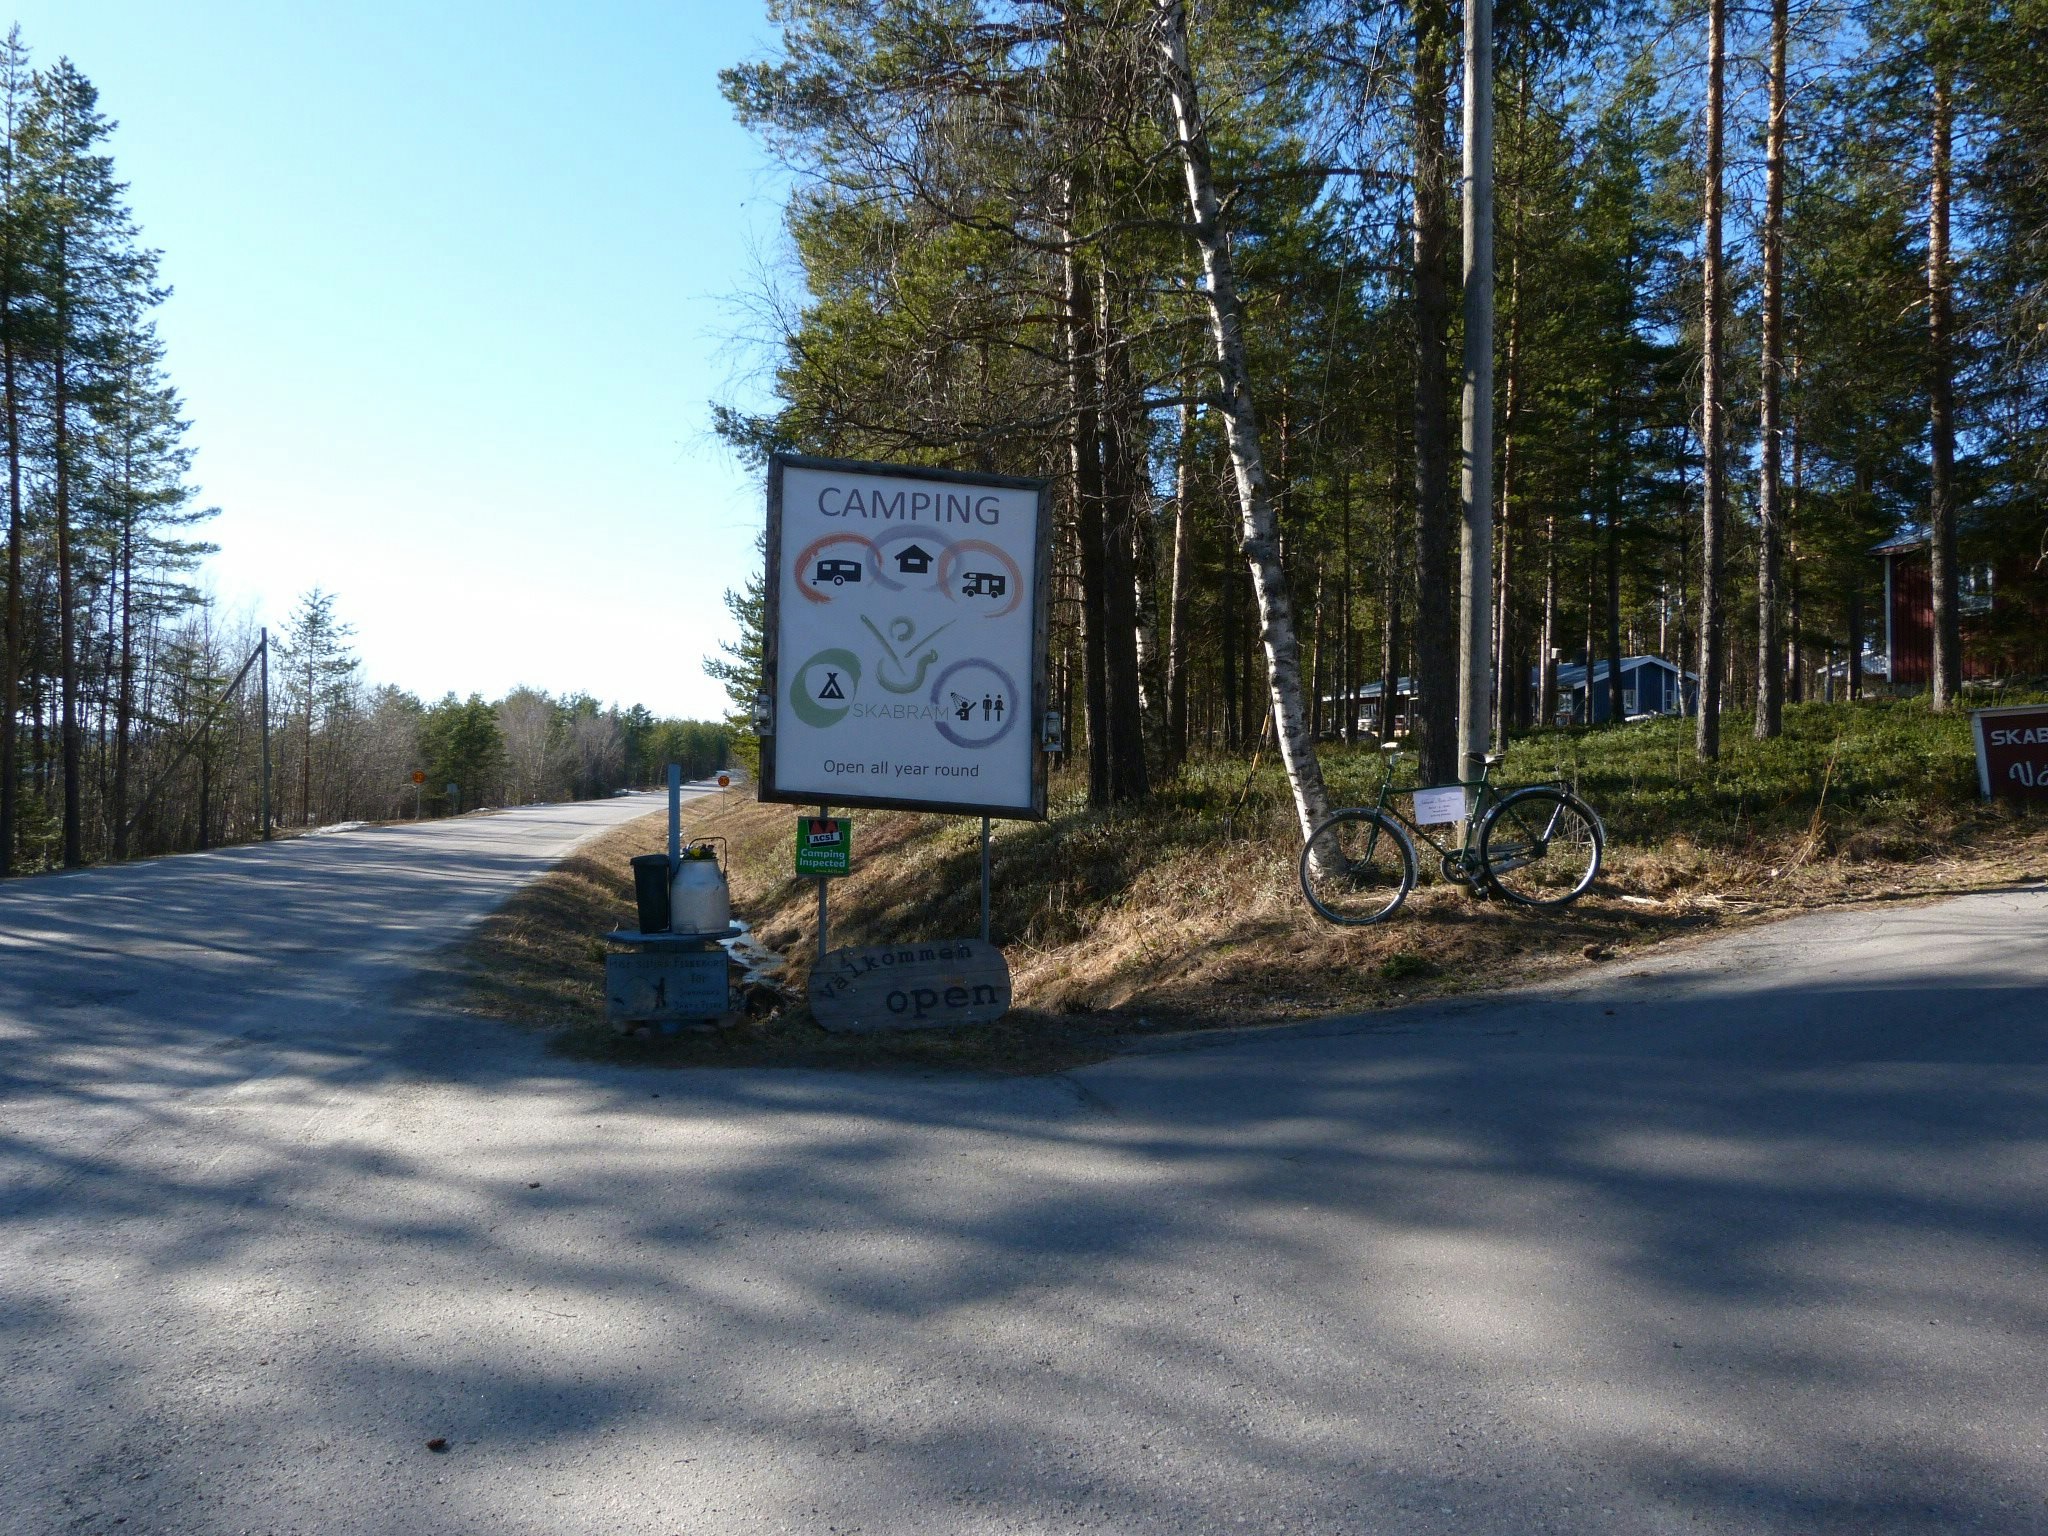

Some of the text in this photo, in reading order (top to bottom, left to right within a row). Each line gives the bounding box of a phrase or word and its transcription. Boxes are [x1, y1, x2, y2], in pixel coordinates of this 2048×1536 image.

[818, 487, 1000, 525] CAMPING
[853, 703, 949, 720] SKABRAM
[824, 760, 979, 777] Open all year round
[813, 834, 834, 842] ACSI
[801, 848, 845, 859] Camping
[800, 858, 845, 868] Inspected
[886, 984, 998, 1018] open
